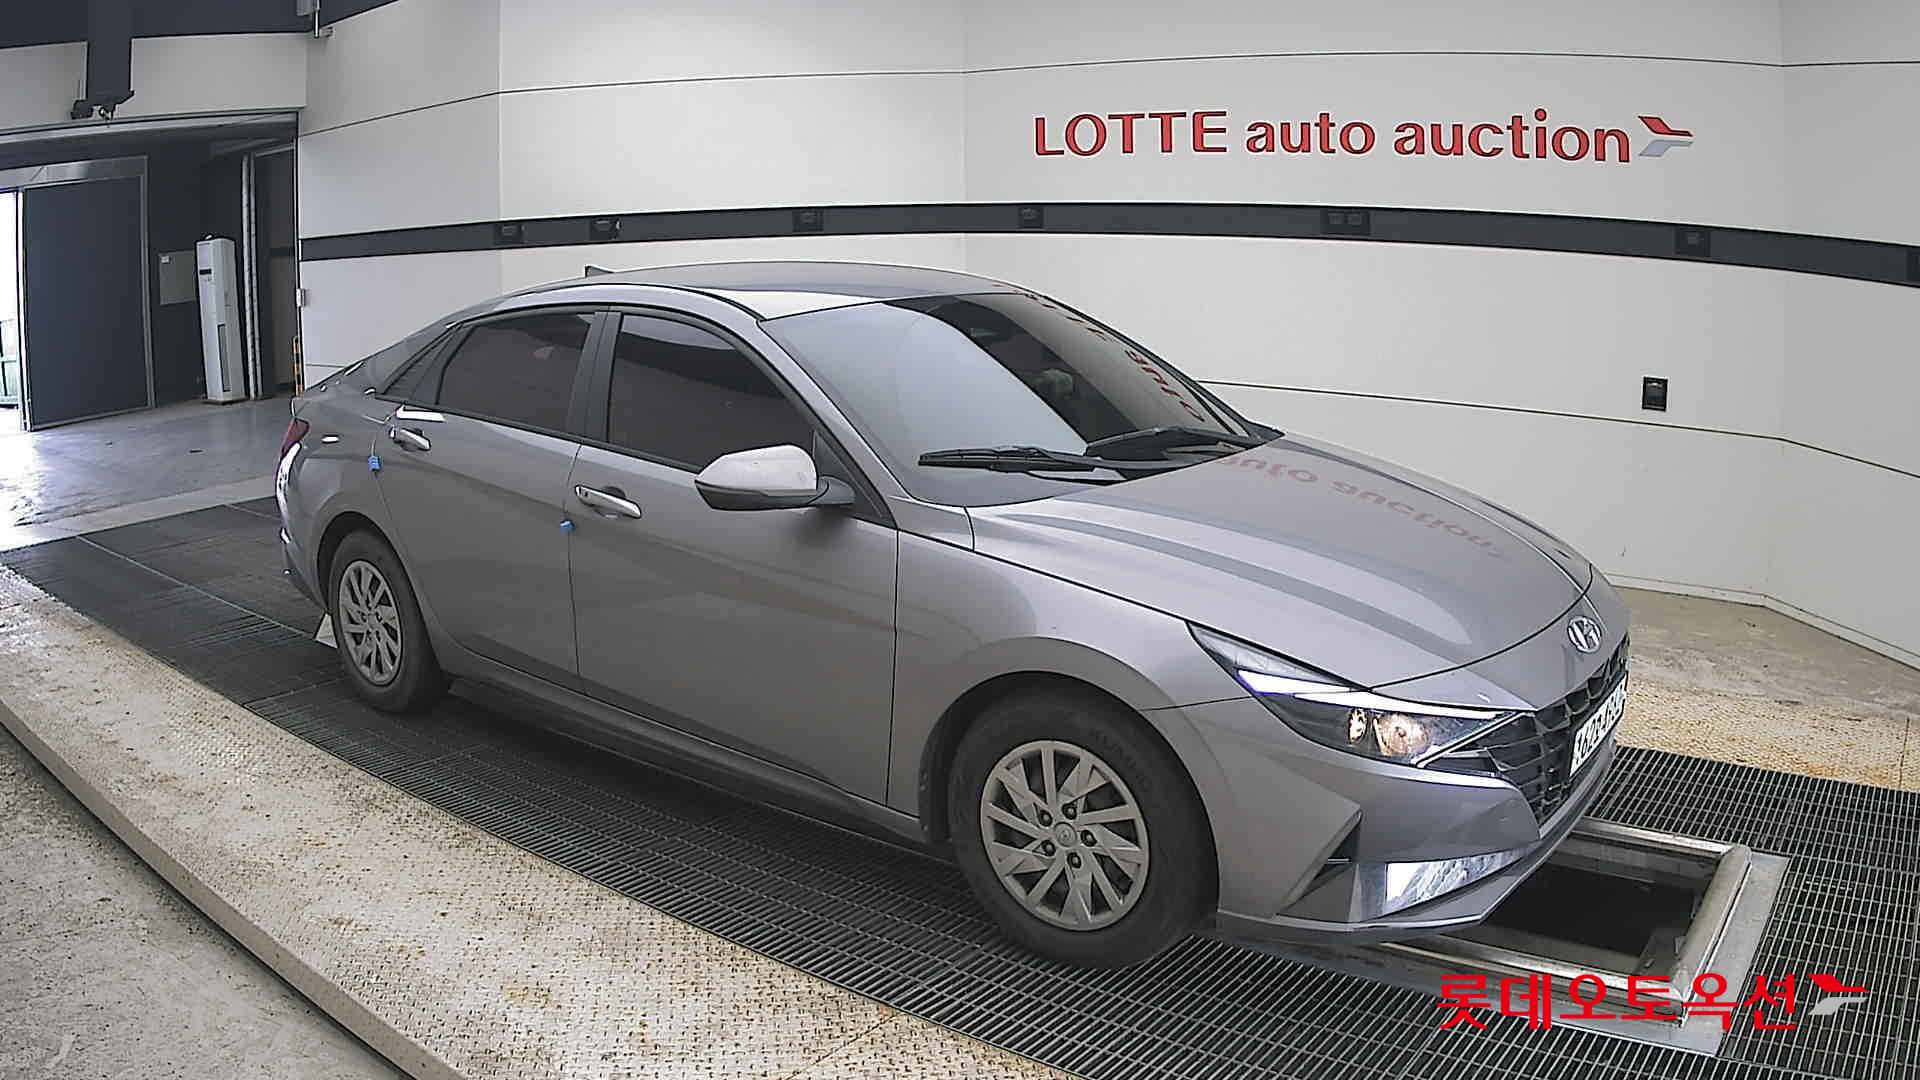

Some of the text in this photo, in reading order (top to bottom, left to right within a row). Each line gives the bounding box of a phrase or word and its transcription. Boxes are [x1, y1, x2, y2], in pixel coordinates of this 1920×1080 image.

[1034, 108, 1631, 163] LOTTE auto auction
